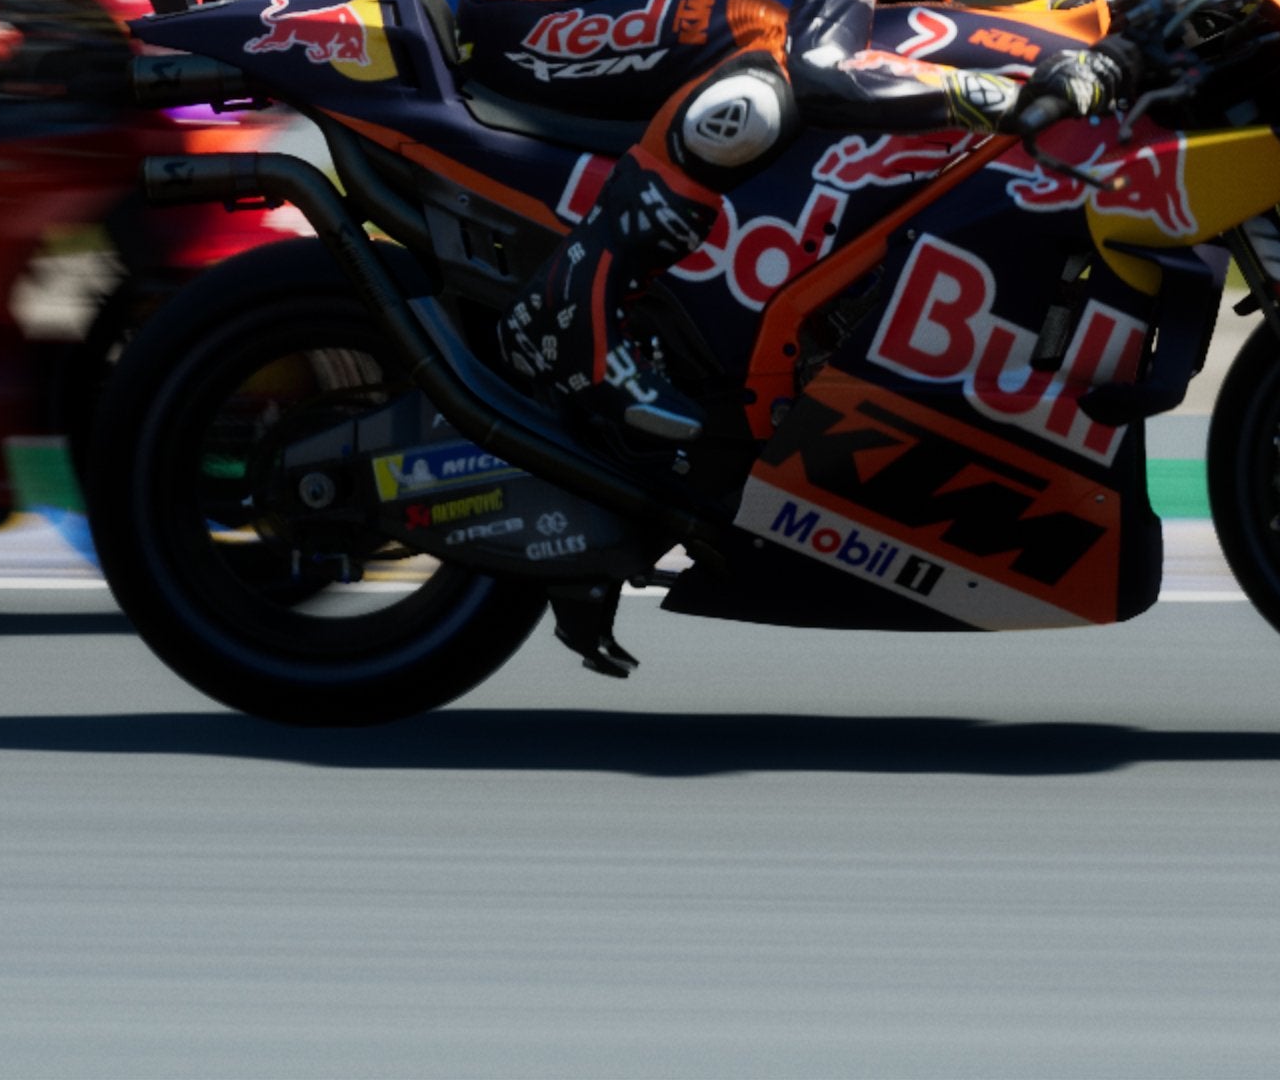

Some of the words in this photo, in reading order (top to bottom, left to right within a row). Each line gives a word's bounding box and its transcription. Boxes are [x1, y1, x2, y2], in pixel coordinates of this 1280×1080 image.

[867, 233, 1147, 468] Bull
[526, 534, 587, 561] GILLES
[757, 399, 1106, 586] KTM
[770, 501, 899, 577] Mobil
